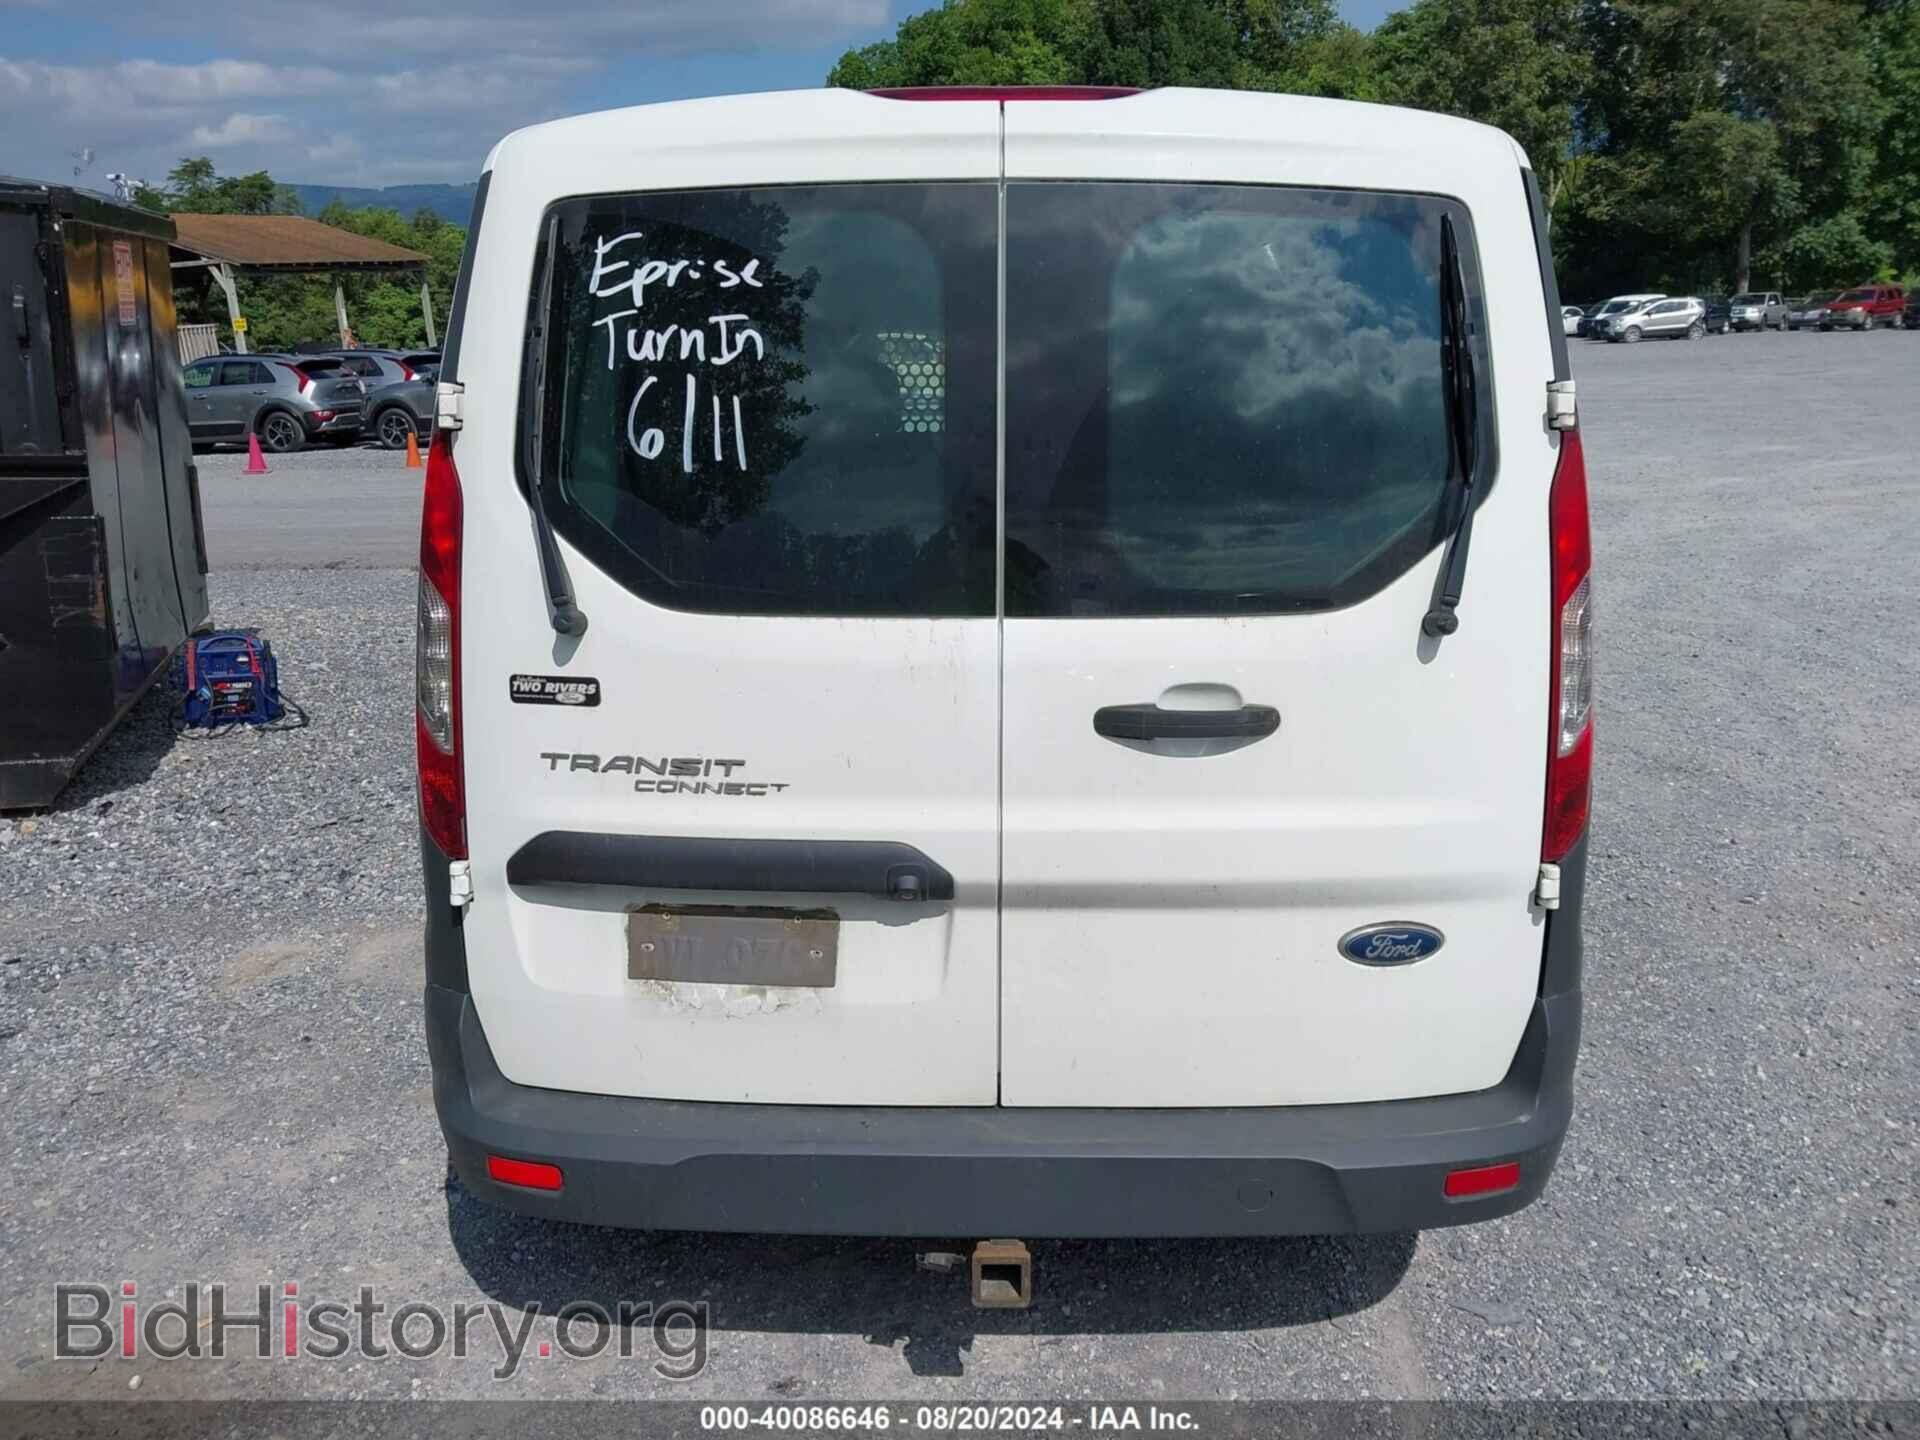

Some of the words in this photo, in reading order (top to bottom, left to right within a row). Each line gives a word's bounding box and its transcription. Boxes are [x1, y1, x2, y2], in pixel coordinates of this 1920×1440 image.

[512, 681, 541, 692] TWO
[544, 683, 597, 695] RIVERS
[540, 752, 746, 778] TRANSIT
[634, 780, 790, 796] CONNECT
[1366, 934, 1422, 958] Ford
